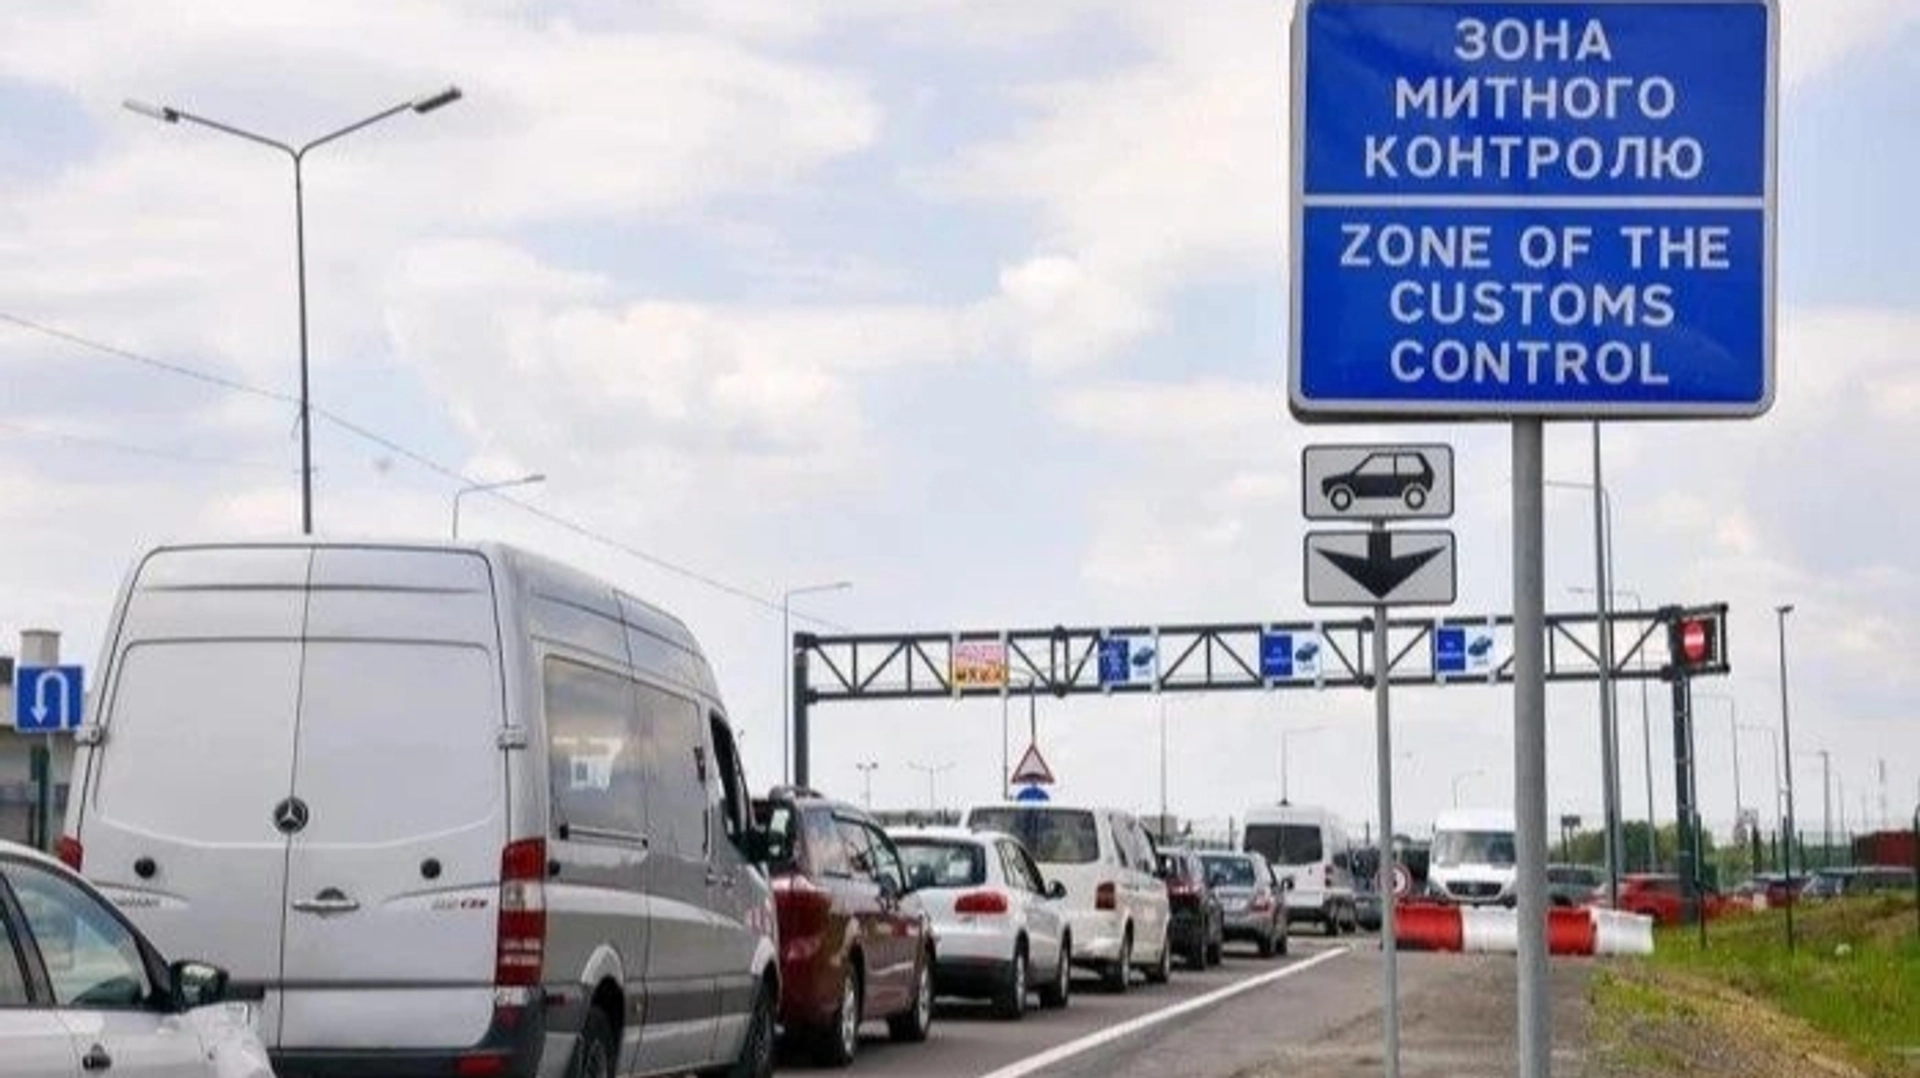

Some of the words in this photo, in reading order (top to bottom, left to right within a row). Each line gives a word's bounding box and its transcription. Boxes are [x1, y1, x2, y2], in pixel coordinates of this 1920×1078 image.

[1454, 18, 1612, 61] ЗОНА
[1396, 76, 1675, 119] МИТНОГО
[1365, 136, 1703, 179] КОНТРОЛЮ
[1341, 224, 1491, 268] ZONE
[1519, 226, 1592, 268] OF
[1621, 227, 1730, 269] THE
[1390, 282, 1675, 327] CUSTOMS
[1391, 341, 1669, 384] CONTROL
